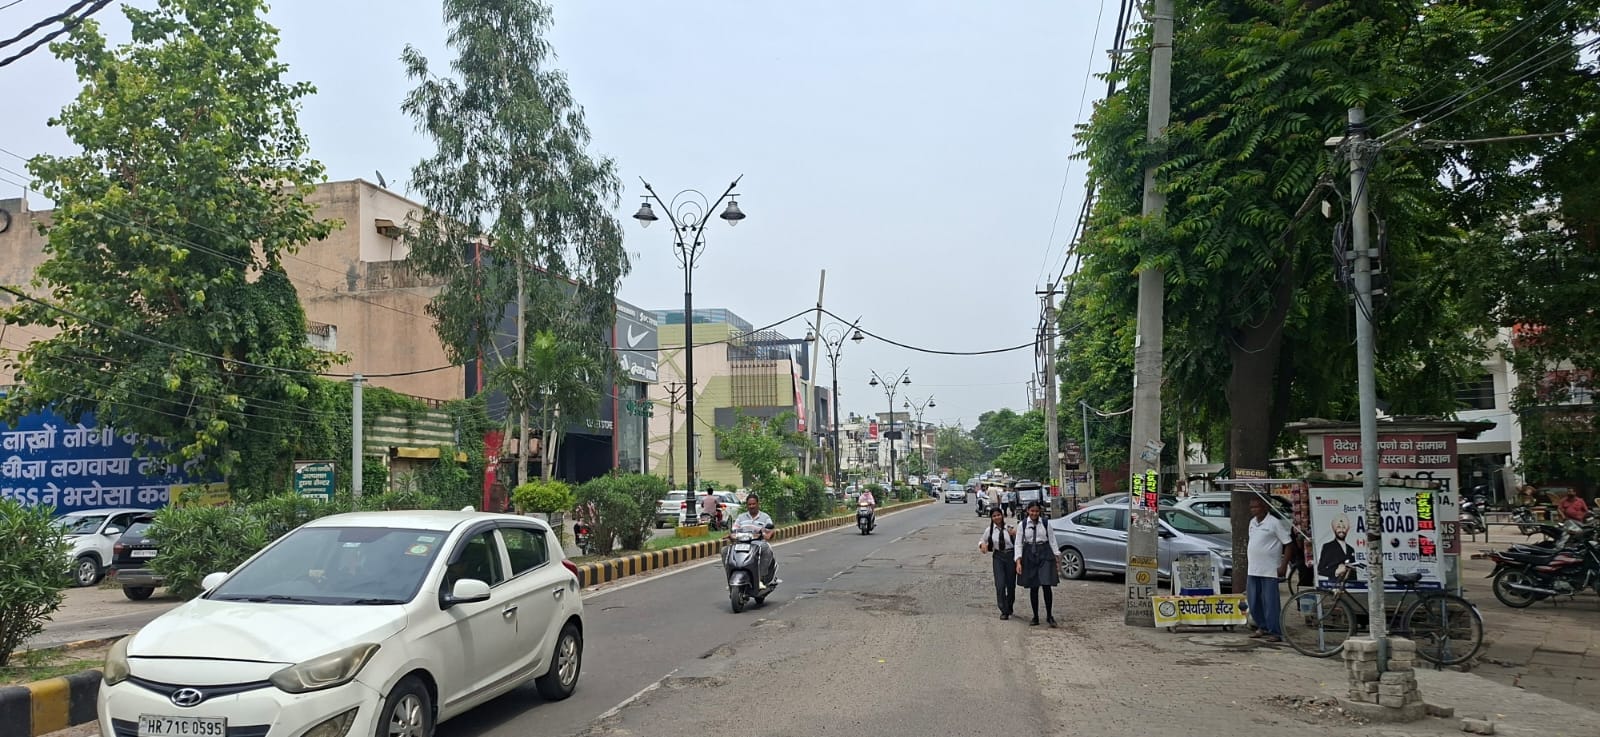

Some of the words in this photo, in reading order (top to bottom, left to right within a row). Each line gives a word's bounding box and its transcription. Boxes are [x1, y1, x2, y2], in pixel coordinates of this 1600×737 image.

[2, 423, 57, 451] लाखों
[1333, 438, 1358, 452] विदेश
[1399, 439, 1413, 451] को
[1416, 439, 1447, 451] सामान
[51, 457, 132, 477] लगवाया
[1331, 452, 1358, 465] भेजना
[1382, 454, 1407, 465] सस्ता
[1418, 454, 1451, 465] आसान
[42, 482, 61, 506] ने
[64, 480, 133, 506] भरोसा
[1379, 497, 1401, 515] tudy
[1356, 515, 1415, 533] AROAD
[147, 719, 162, 734] HR
[166, 719, 189, 735] 71C
[192, 720, 222, 736] 0595
